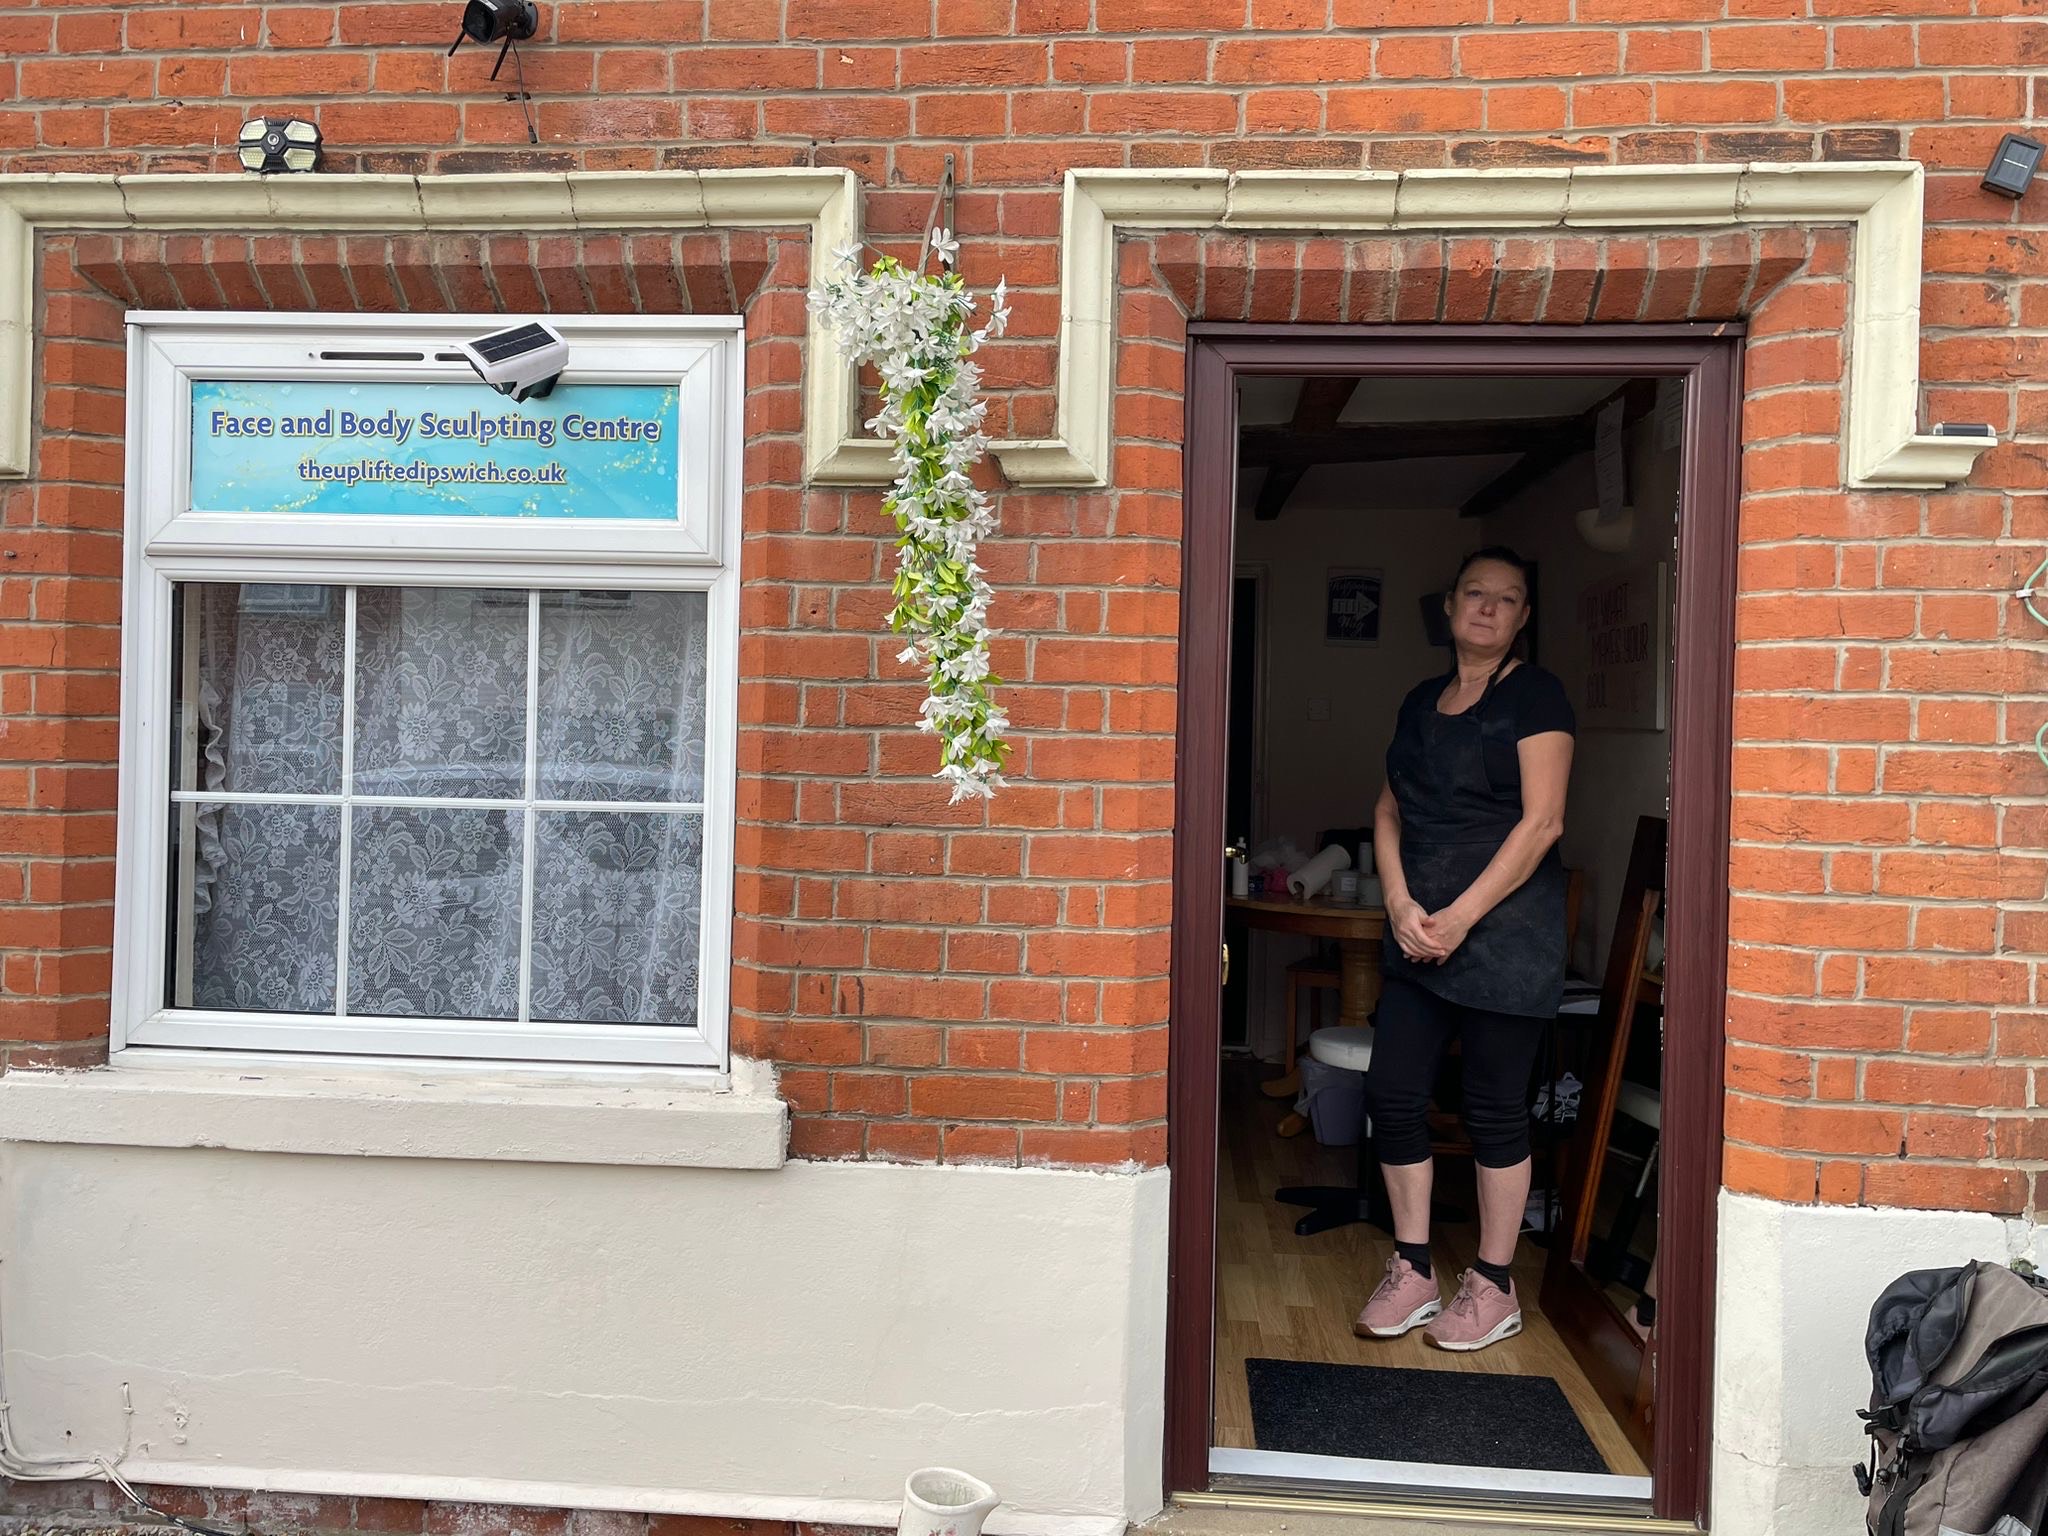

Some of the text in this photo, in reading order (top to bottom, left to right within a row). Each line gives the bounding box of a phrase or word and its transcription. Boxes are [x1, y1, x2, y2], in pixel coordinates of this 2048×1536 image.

[211, 409, 661, 446] Face and Body Sculpting Centre
[298, 459, 566, 487] theupliftedipswich.co.uk
